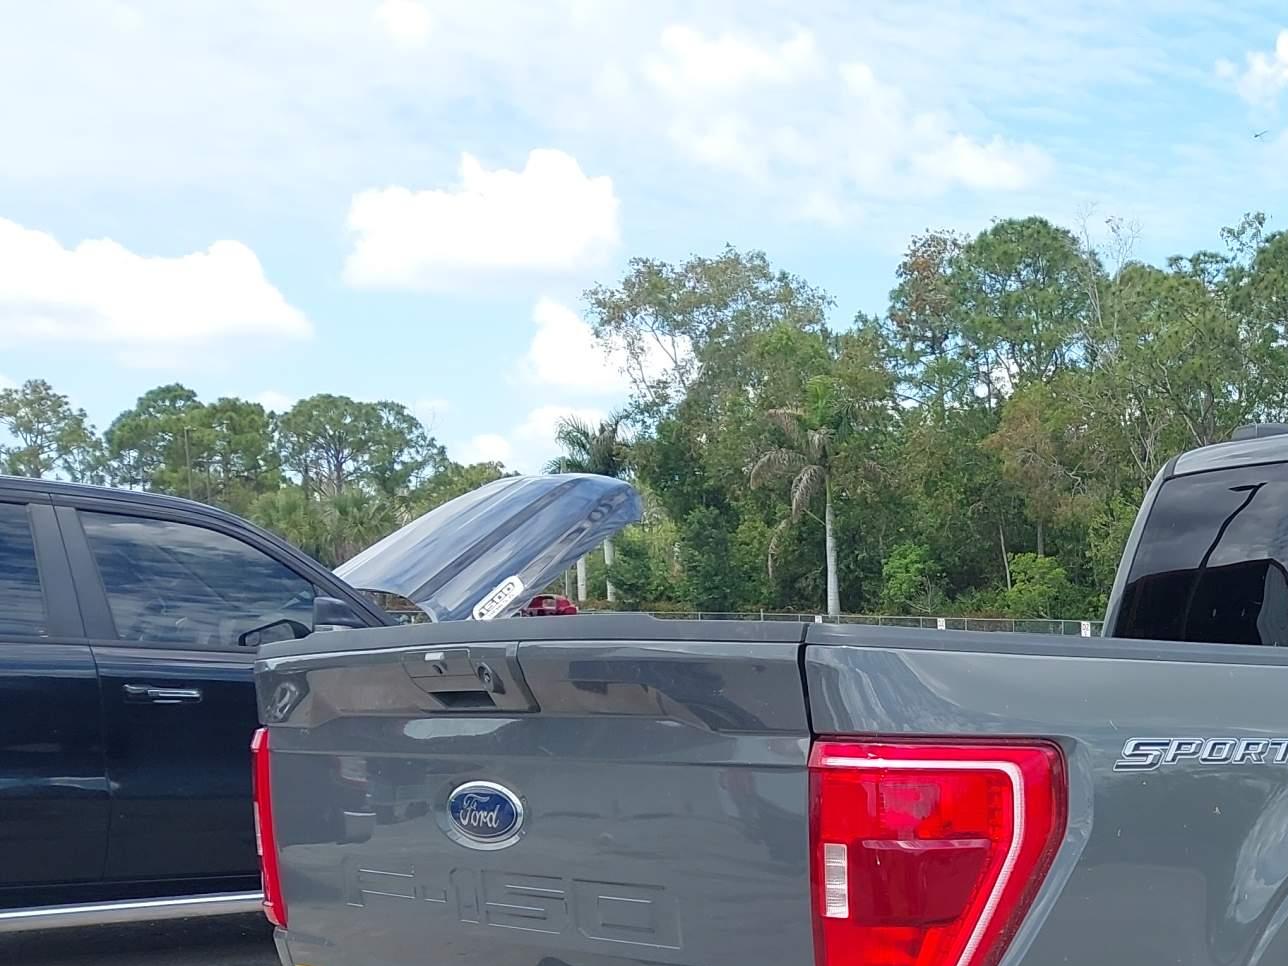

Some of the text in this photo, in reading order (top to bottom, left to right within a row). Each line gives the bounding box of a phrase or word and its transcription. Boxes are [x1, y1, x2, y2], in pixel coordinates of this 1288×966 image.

[478, 581, 516, 614] 1500
[459, 793, 500, 828] Ford
[343, 857, 682, 949] F-150
